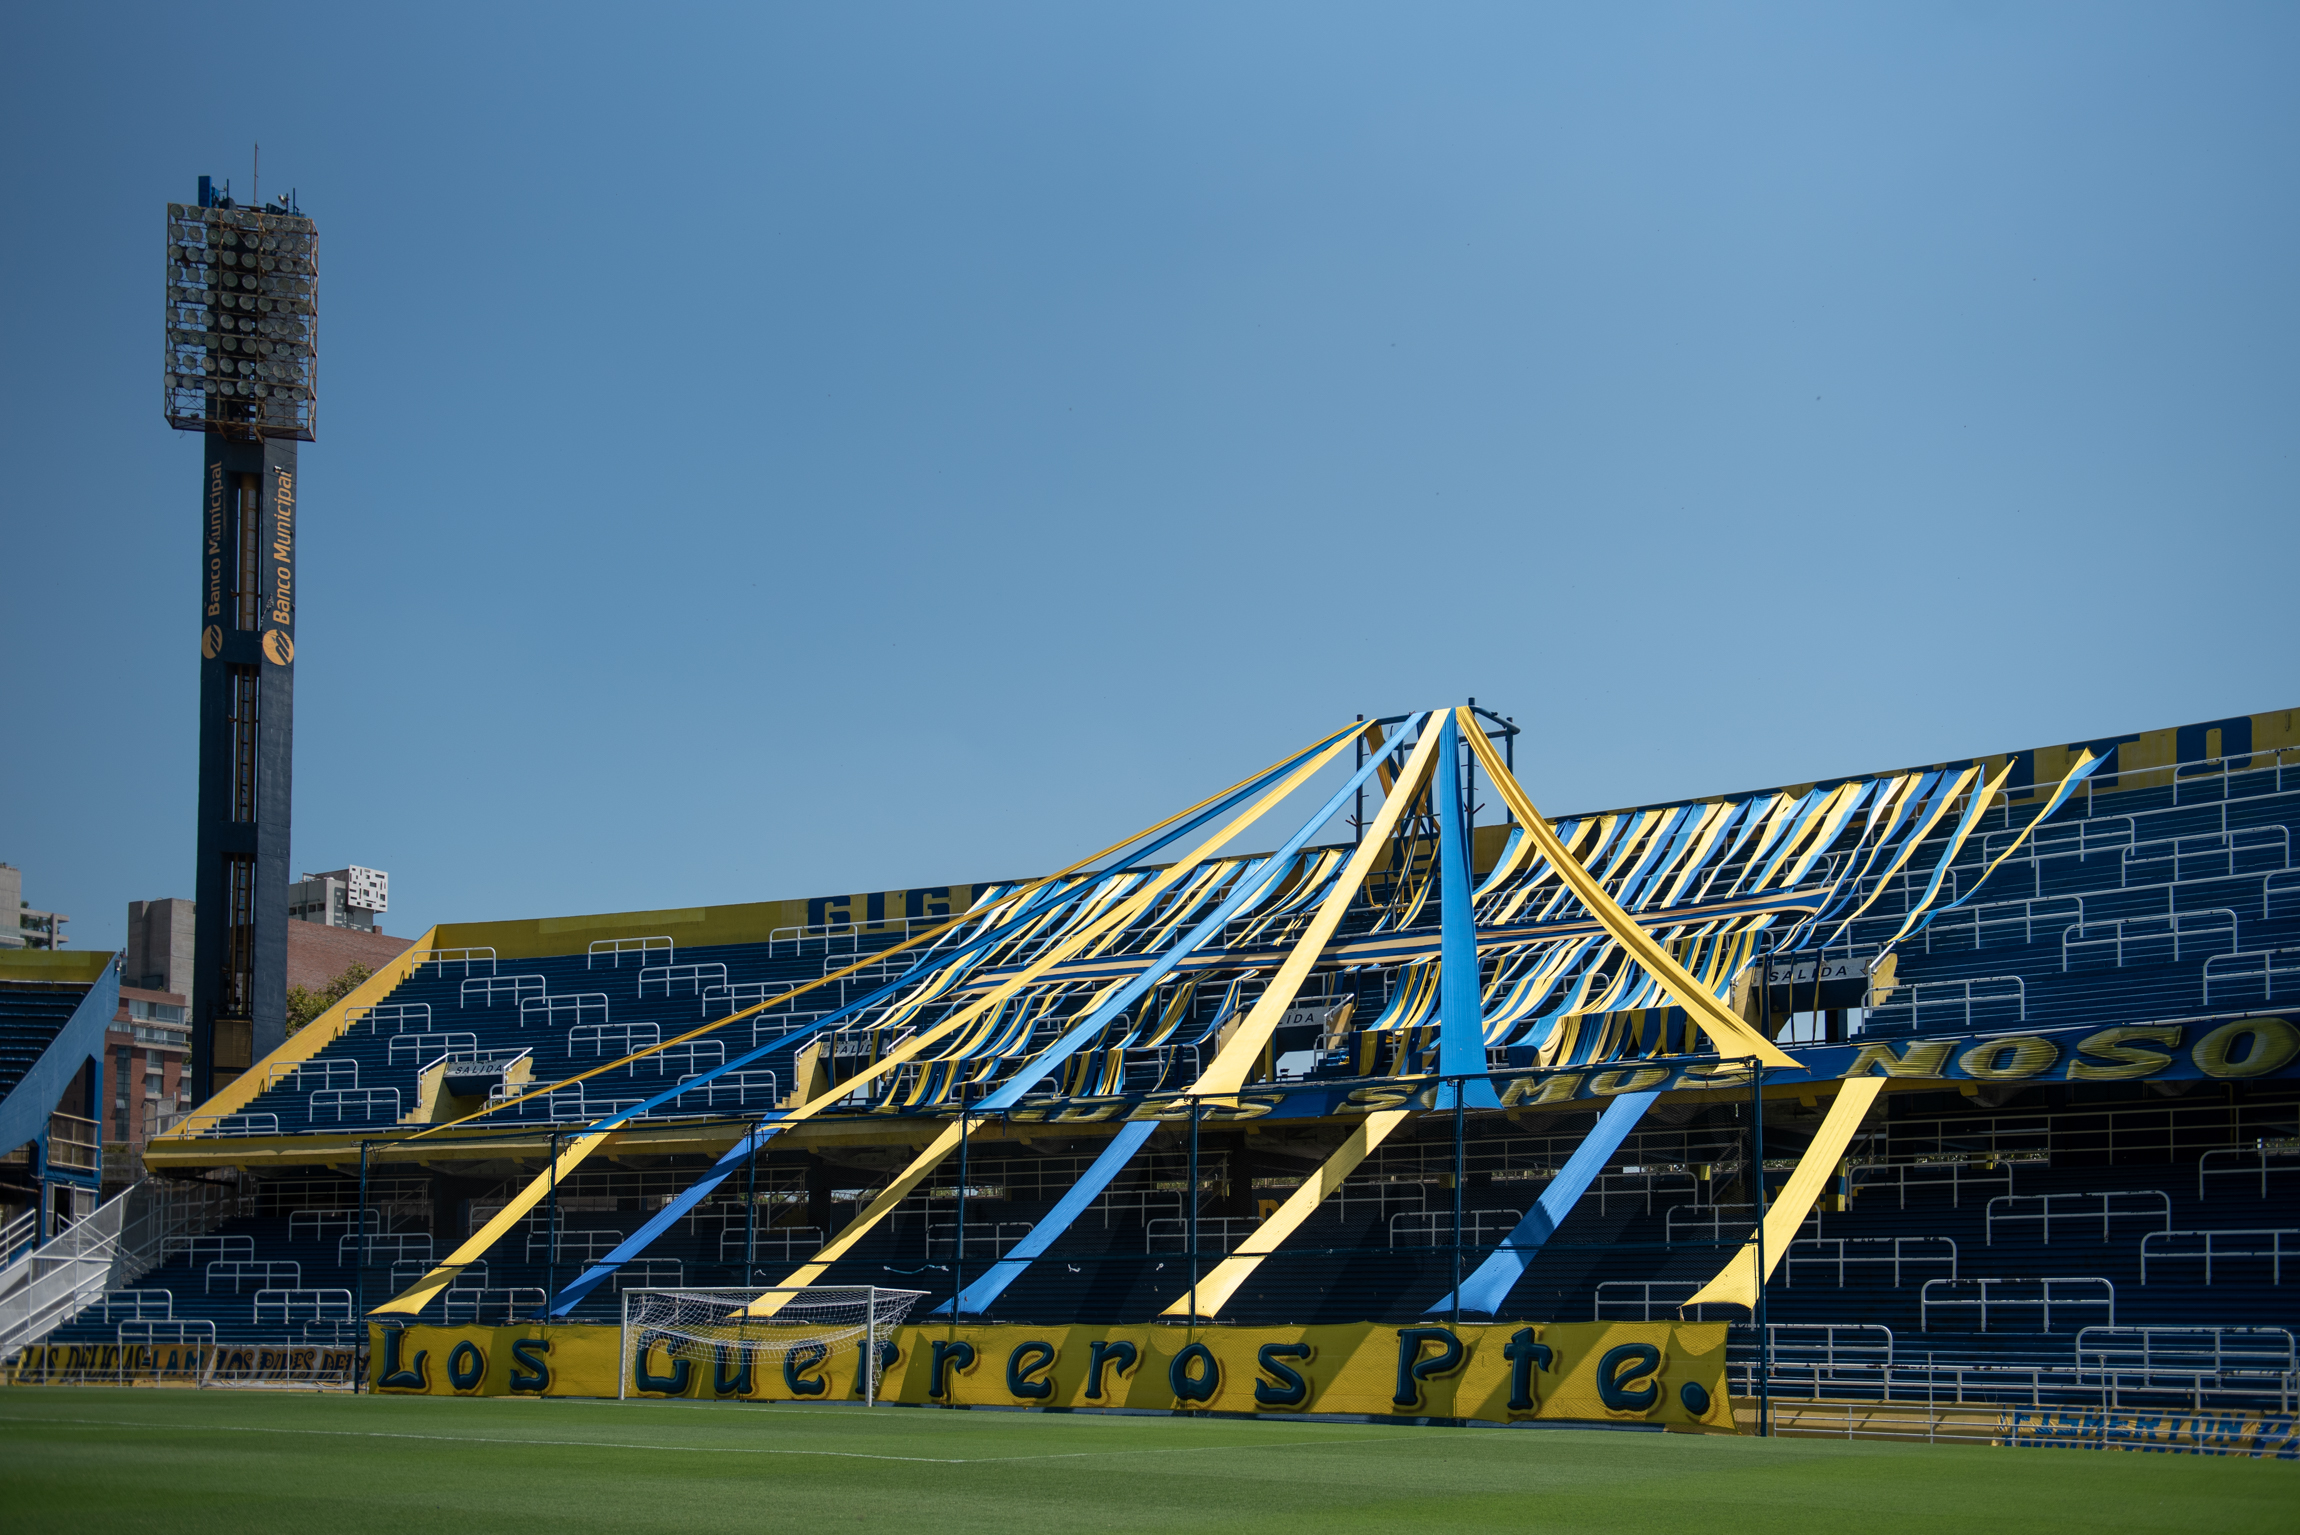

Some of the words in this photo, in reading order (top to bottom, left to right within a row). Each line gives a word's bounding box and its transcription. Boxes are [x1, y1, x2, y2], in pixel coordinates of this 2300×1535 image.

[208, 460, 224, 556] Municipal
[273, 469, 296, 564] Municipal
[207, 557, 221, 617] Banco
[273, 567, 291, 625] Banco
[1769, 965, 1847, 982] SALIDA
[454, 1064, 503, 1075] SALIDA
[1332, 1060, 1765, 1115] SMOS
[1392, 1326, 1711, 1416] Pte.
[2010, 1404, 2246, 1442] FISHERTON
